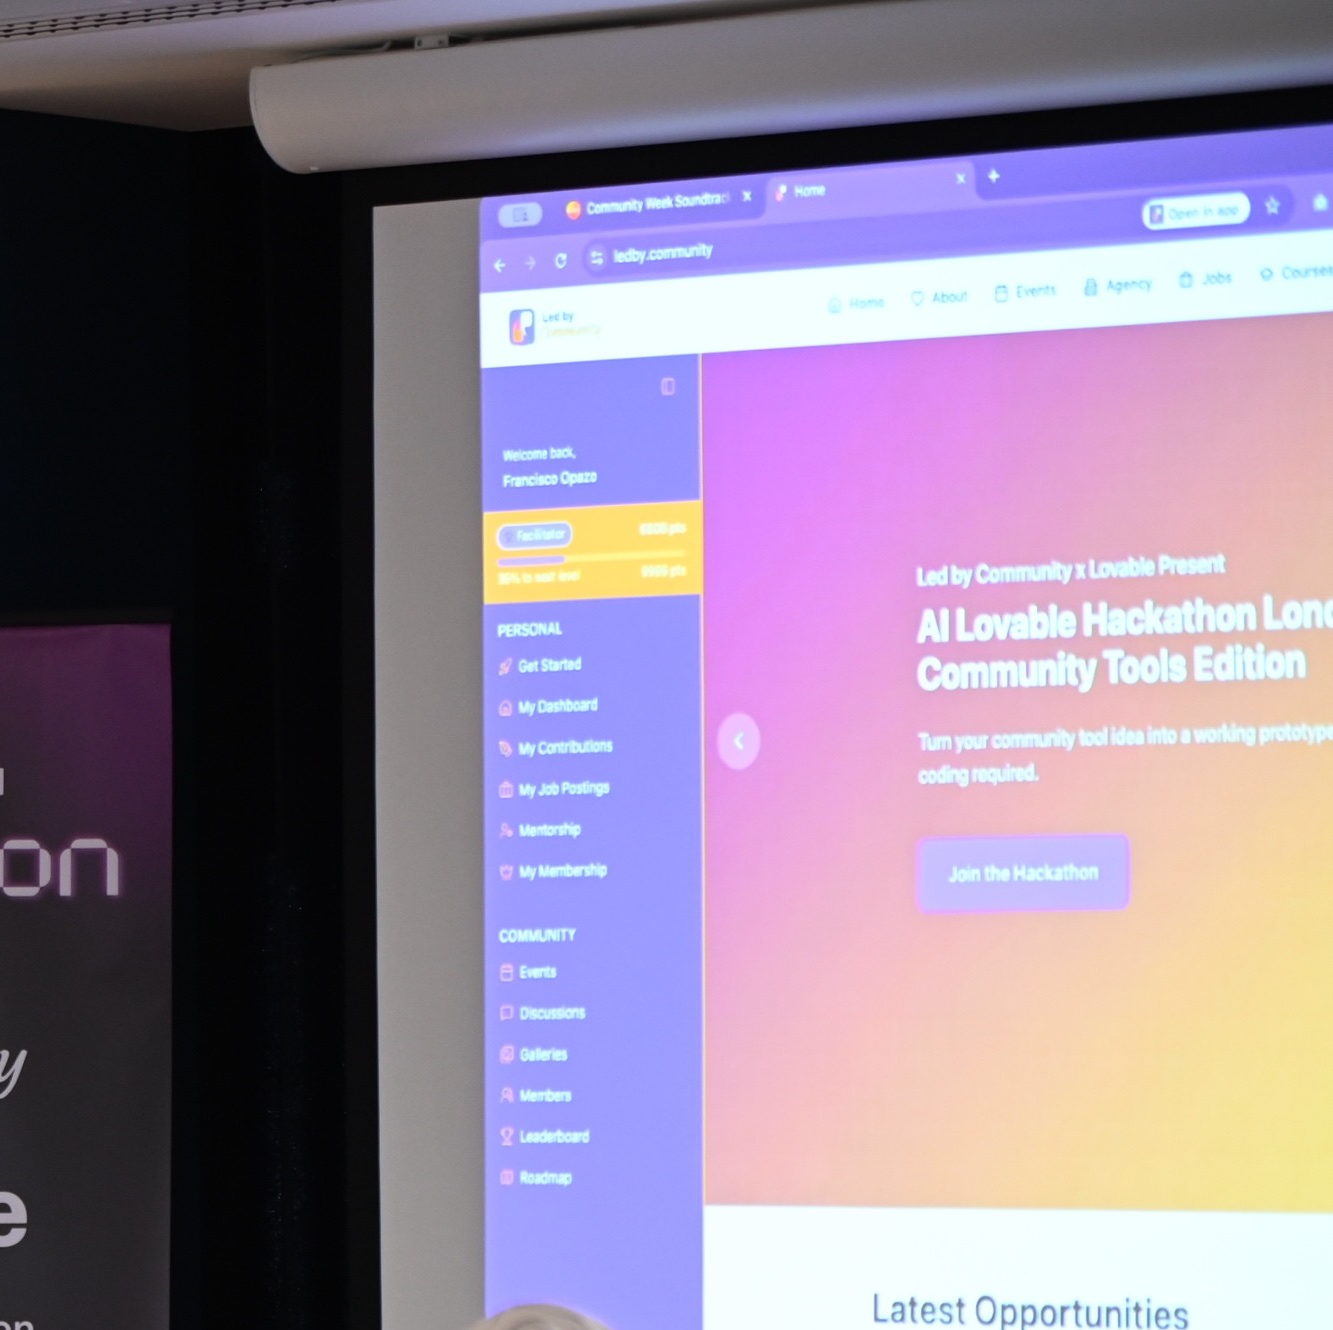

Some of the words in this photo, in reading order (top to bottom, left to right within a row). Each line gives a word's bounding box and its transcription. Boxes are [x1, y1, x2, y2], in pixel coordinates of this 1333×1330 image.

[794, 184, 825, 197] Home
[586, 198, 643, 216] Community
[645, 196, 673, 211] Week
[1169, 206, 1199, 222] Open
[1214, 204, 1239, 220] app
[613, 243, 713, 265] ledby.community
[1107, 276, 1153, 295] Agency
[1201, 270, 1232, 287] Jobs
[933, 289, 968, 305] About
[1016, 283, 1057, 299] Events
[850, 295, 885, 311] Home
[503, 448, 548, 462] Welcome
[503, 472, 558, 488] Francisco
[560, 471, 597, 486] Opazo
[516, 527, 566, 542] Facilitator
[917, 565, 949, 587] Led
[951, 564, 972, 588] by
[975, 560, 1073, 585] Community
[1088, 556, 1155, 581] Lovable
[1158, 554, 1226, 576] Present
[917, 606, 949, 643] AI
[955, 603, 1077, 642] Lovable
[1082, 597, 1257, 638] Hackathon
[497, 622, 563, 638] PERSONAL
[518, 658, 539, 674] Get
[541, 656, 582, 672] Started
[917, 650, 1097, 693] Community
[1102, 647, 1187, 685] Tools
[1193, 643, 1307, 682] Edition
[518, 700, 536, 717] My
[538, 697, 598, 714] Dashboard
[918, 731, 952, 752] Turn
[954, 732, 989, 754] your
[991, 727, 1077, 751] community
[1079, 726, 1109, 747] tool
[1111, 725, 1145, 746] idea
[1147, 724, 1177, 745] into
[1180, 728, 1191, 744] a
[1194, 721, 1256, 747] working
[519, 741, 536, 758] My
[538, 738, 613, 756] Contributions
[918, 764, 970, 788] coding
[972, 762, 1039, 786] required.
[519, 783, 536, 799] My
[538, 781, 559, 797] Job
[561, 780, 610, 797] Postings
[519, 821, 581, 840] Mentorship
[519, 864, 537, 881] My
[538, 862, 607, 880] Membership
[948, 865, 981, 883] Join
[984, 864, 1010, 882] the
[1013, 862, 1099, 882] Hackathon
[499, 928, 577, 944] COMMUNITY
[519, 965, 557, 980] Events
[519, 1005, 586, 1021] Discussions
[519, 1046, 568, 1062] Galleries
[519, 1088, 572, 1103] Members
[519, 1129, 590, 1145] Leaderboard
[519, 1171, 572, 1187] Roadmap
[872, 1293, 965, 1328] Latest
